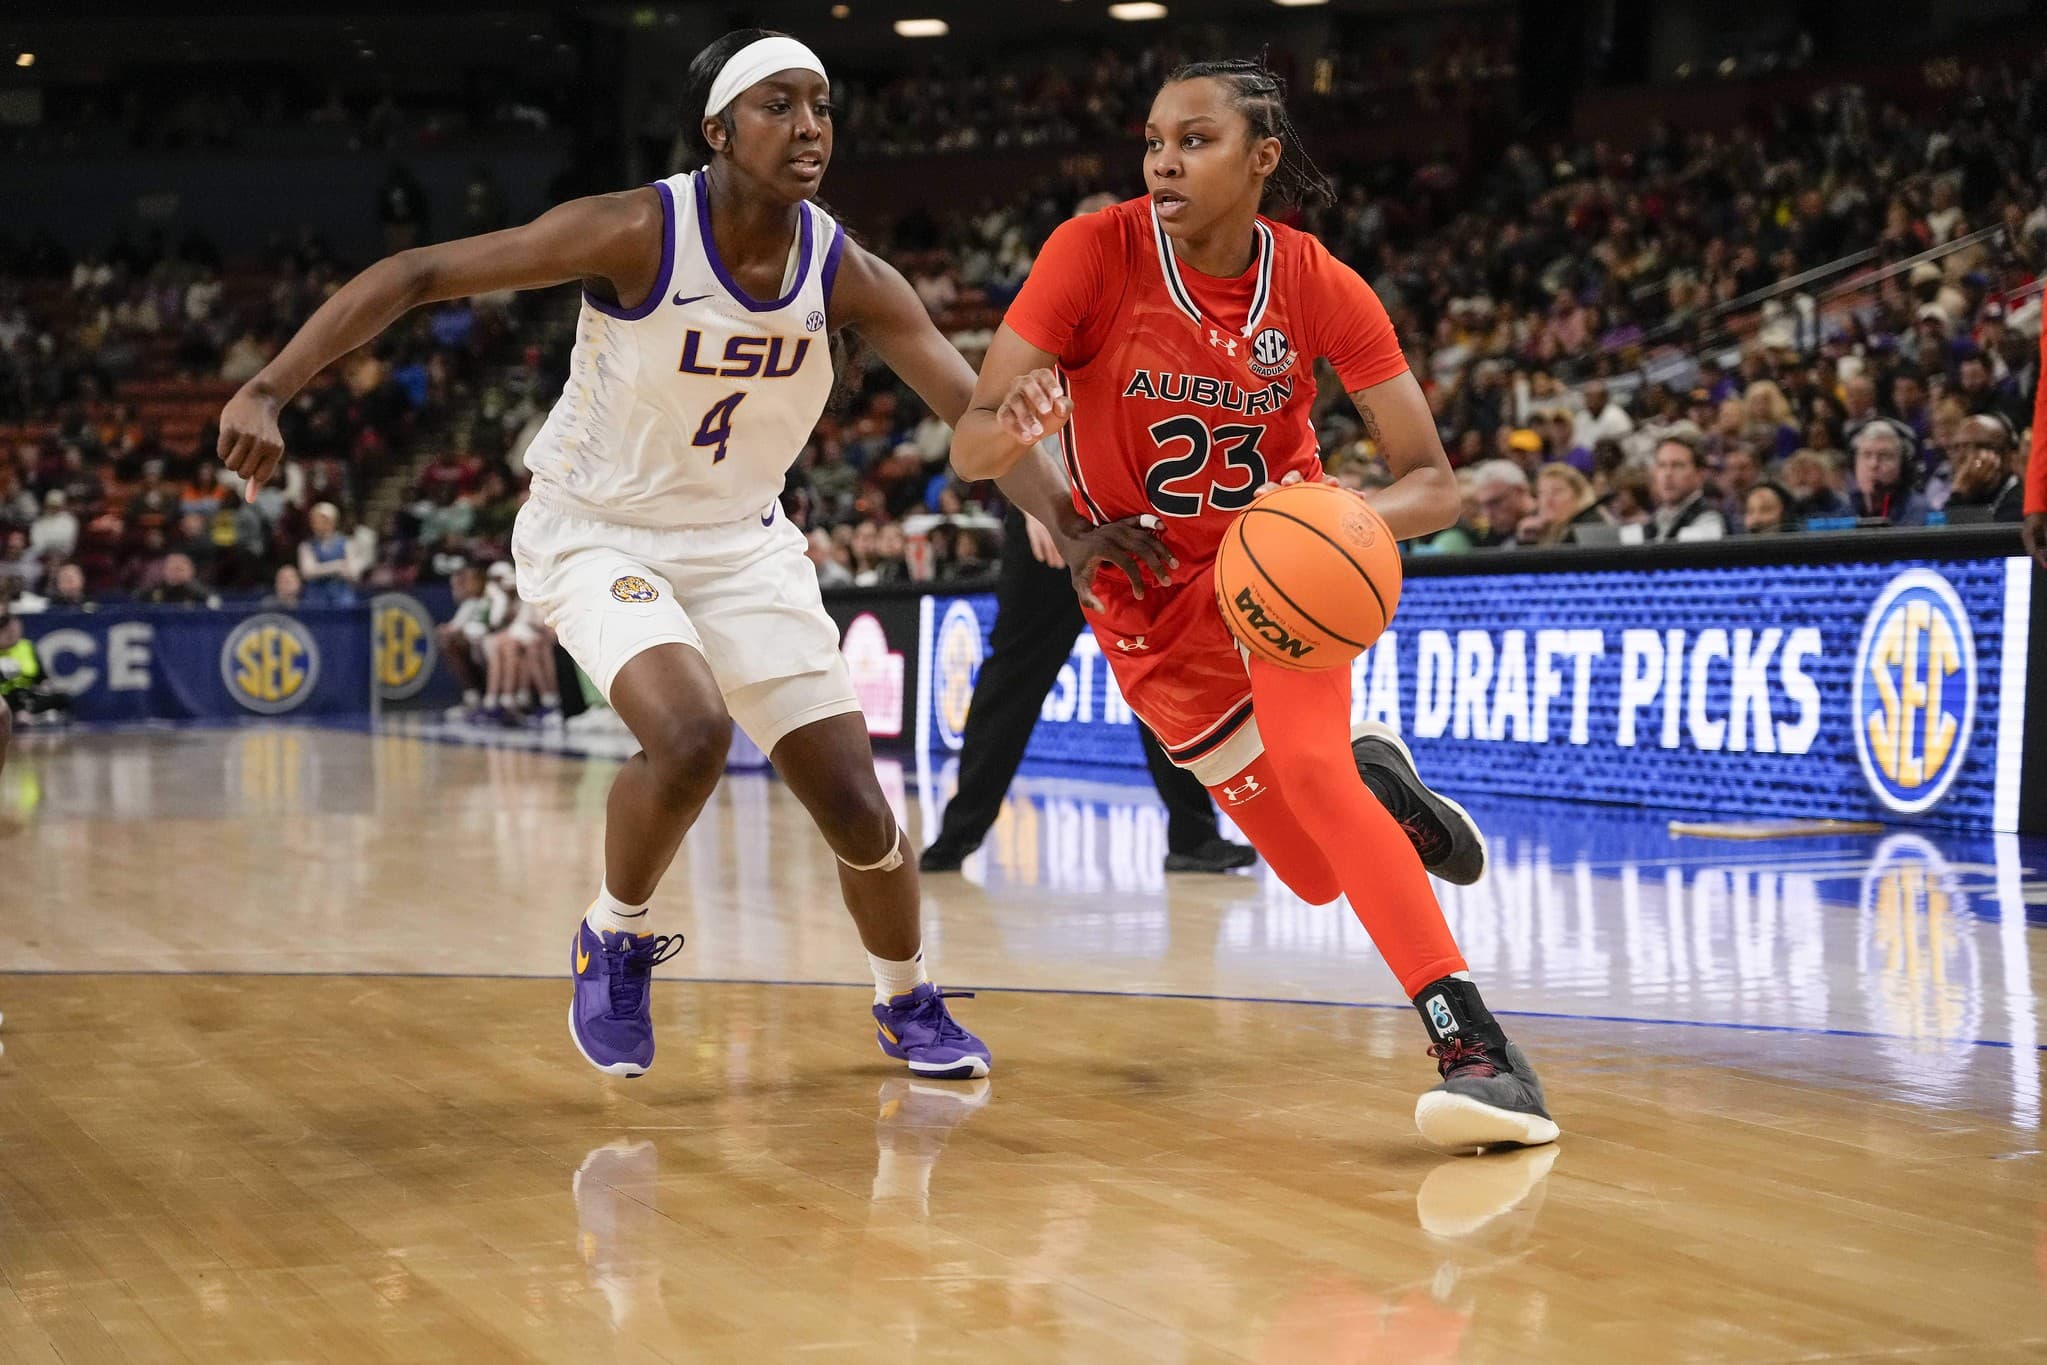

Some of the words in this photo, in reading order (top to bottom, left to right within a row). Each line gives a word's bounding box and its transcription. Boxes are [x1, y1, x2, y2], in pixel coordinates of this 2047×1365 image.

[677, 329, 812, 379] LSU
[806, 311, 824, 332] SEC
[1254, 329, 1288, 365] SEC
[1122, 369, 1295, 416] AUBURN
[1251, 358, 1293, 376] GRADUATE
[690, 391, 749, 465] 4
[1145, 414, 1268, 518] 23
[1235, 586, 1315, 660] NCAA
[235, 625, 308, 702] SEC
[1412, 627, 1604, 745] DRAFT
[1615, 627, 1823, 755] PICKS
[1866, 599, 1962, 789] SEC
